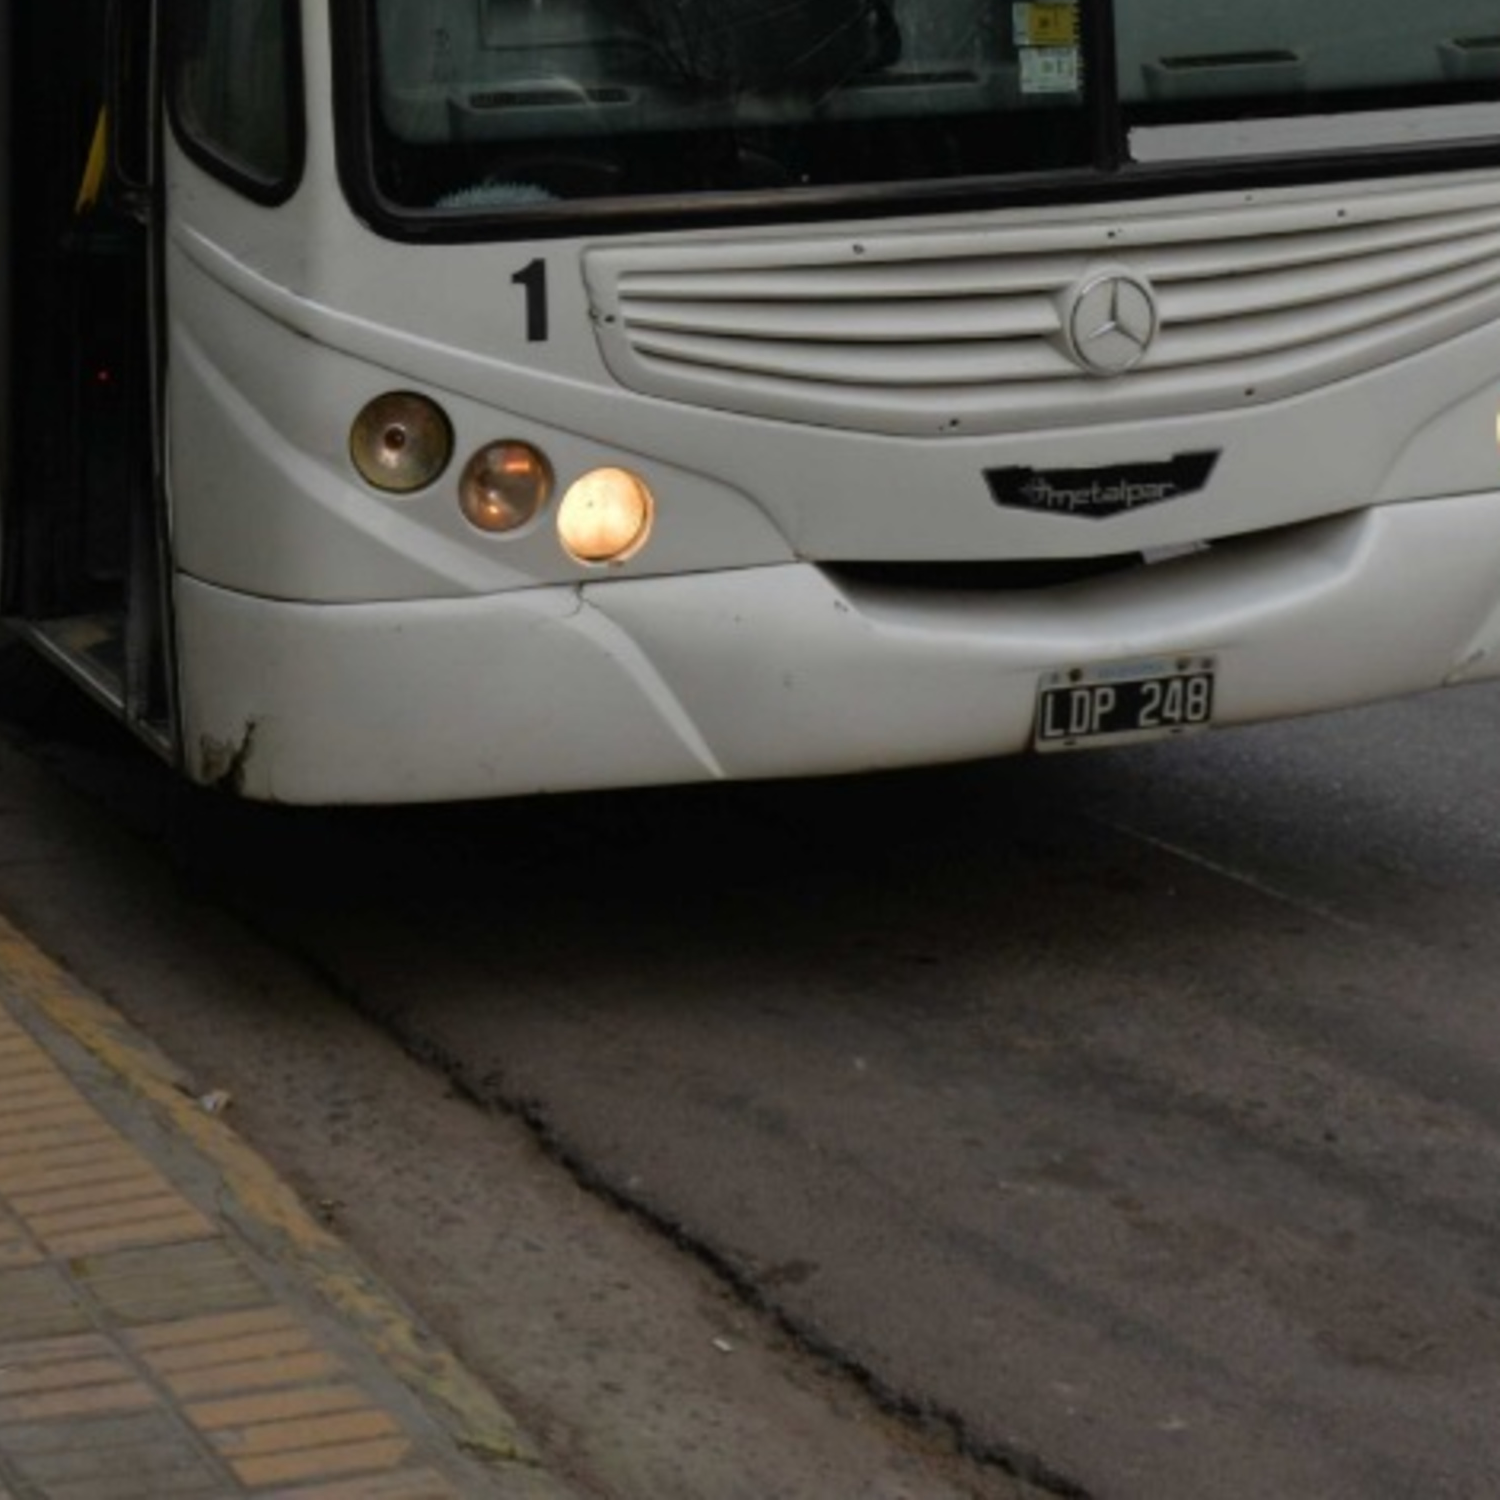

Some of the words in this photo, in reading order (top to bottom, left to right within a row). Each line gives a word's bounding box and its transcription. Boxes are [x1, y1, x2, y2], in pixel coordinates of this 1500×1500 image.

[510, 258, 549, 342] 1
[1043, 686, 1116, 738] LDP
[1137, 676, 1209, 728] 248
